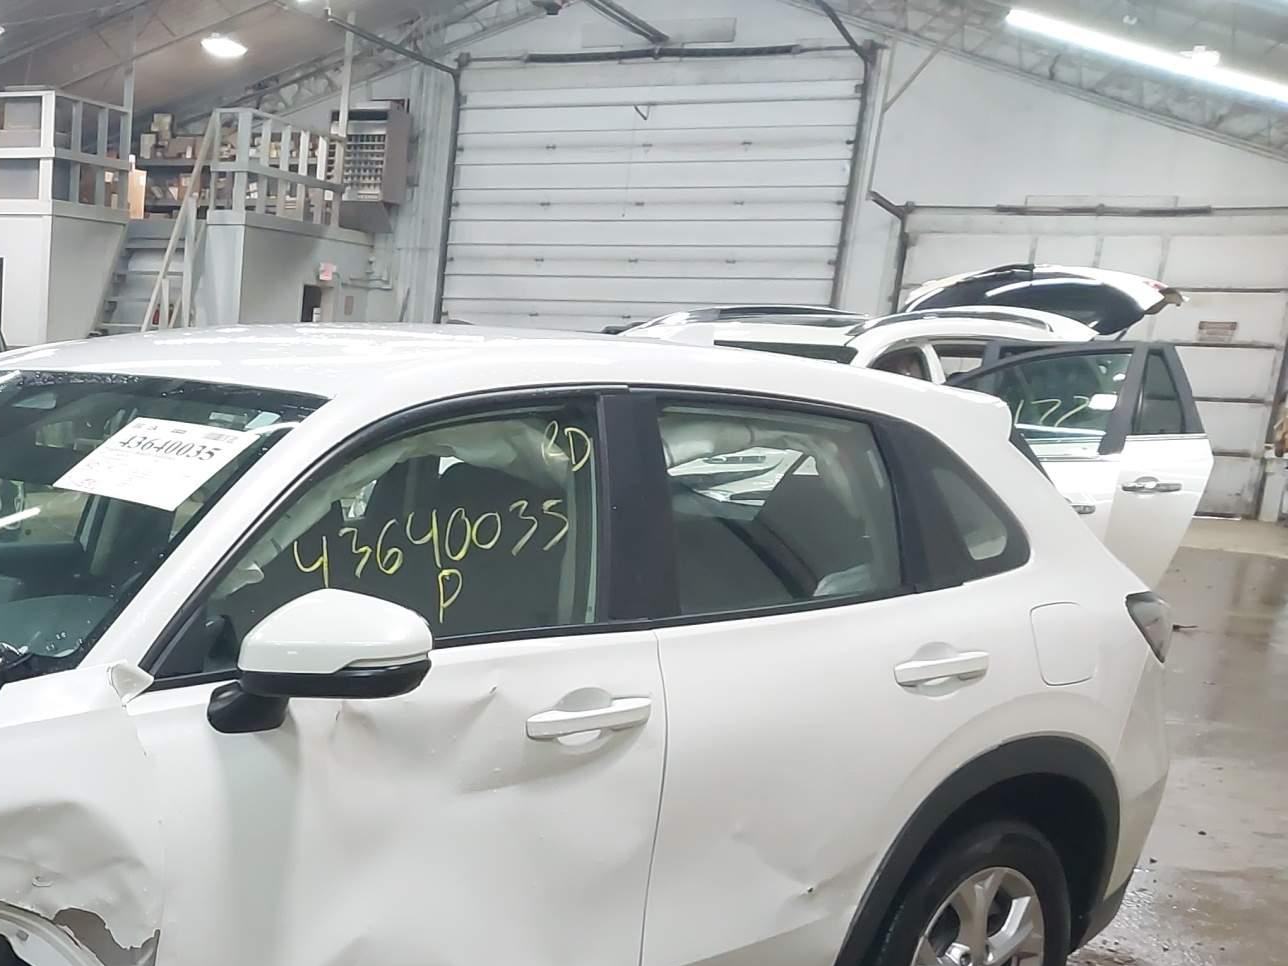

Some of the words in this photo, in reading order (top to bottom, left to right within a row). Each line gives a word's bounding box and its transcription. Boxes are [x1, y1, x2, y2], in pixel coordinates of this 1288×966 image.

[120, 435, 222, 461] 43640035
[293, 500, 570, 589] 43640035
[437, 568, 463, 624] P
